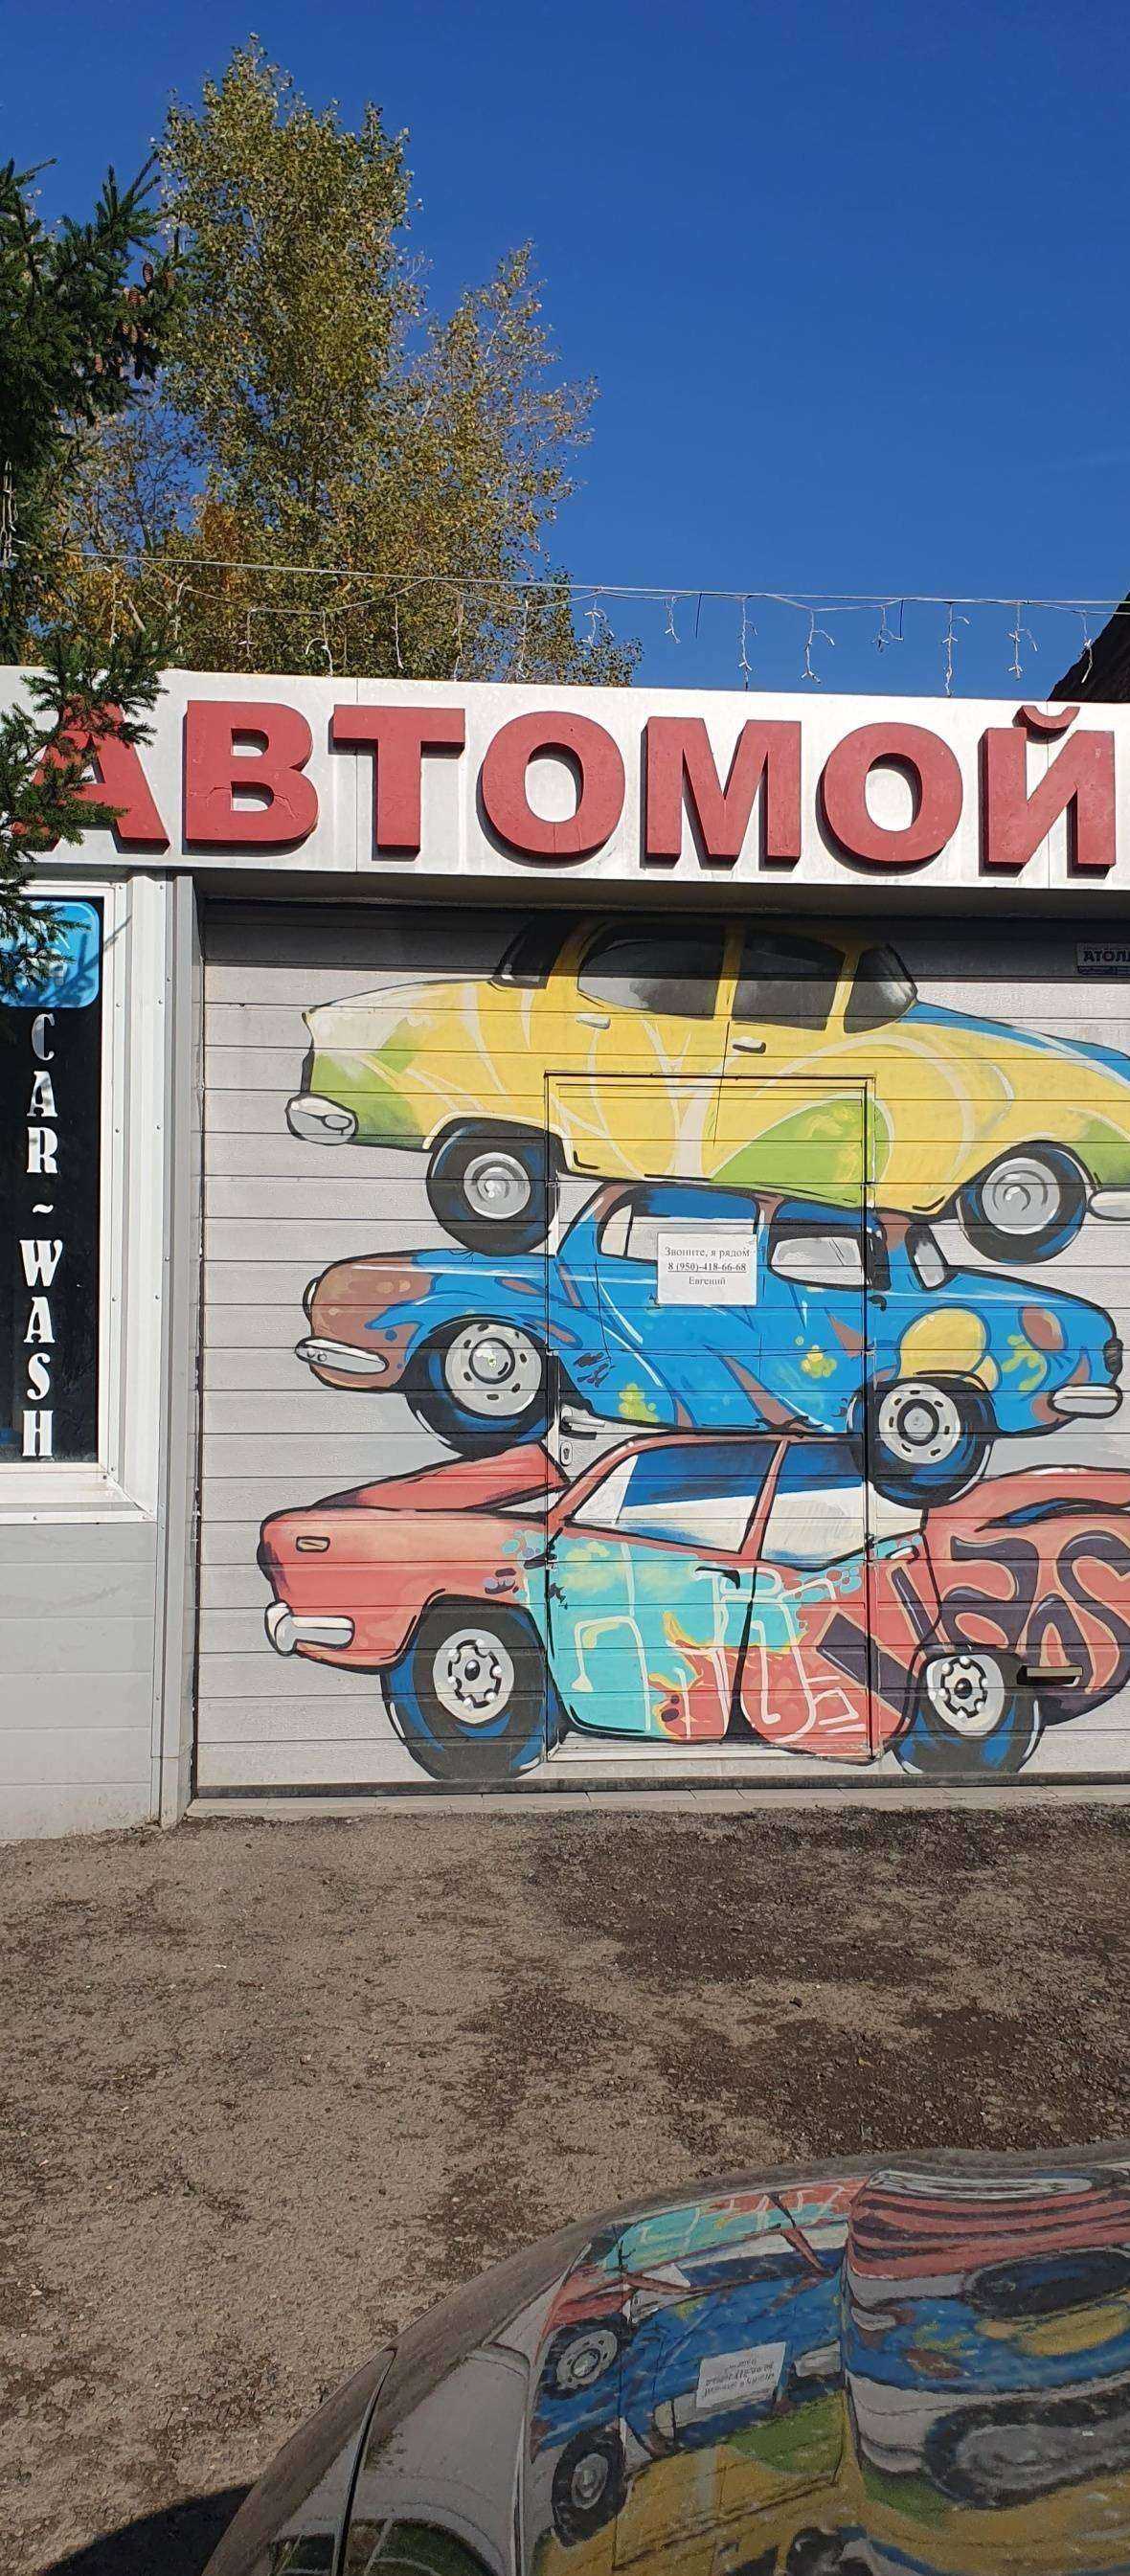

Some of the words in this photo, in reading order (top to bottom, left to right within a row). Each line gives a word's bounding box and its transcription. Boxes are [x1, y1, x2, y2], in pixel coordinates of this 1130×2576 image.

[11, 696, 1117, 873] АВТОМОЙ
[665, 1246, 709, 1257] Звоните,
[719, 1248, 750, 1259] рядом
[689, 1276, 726, 1285] Евгений
